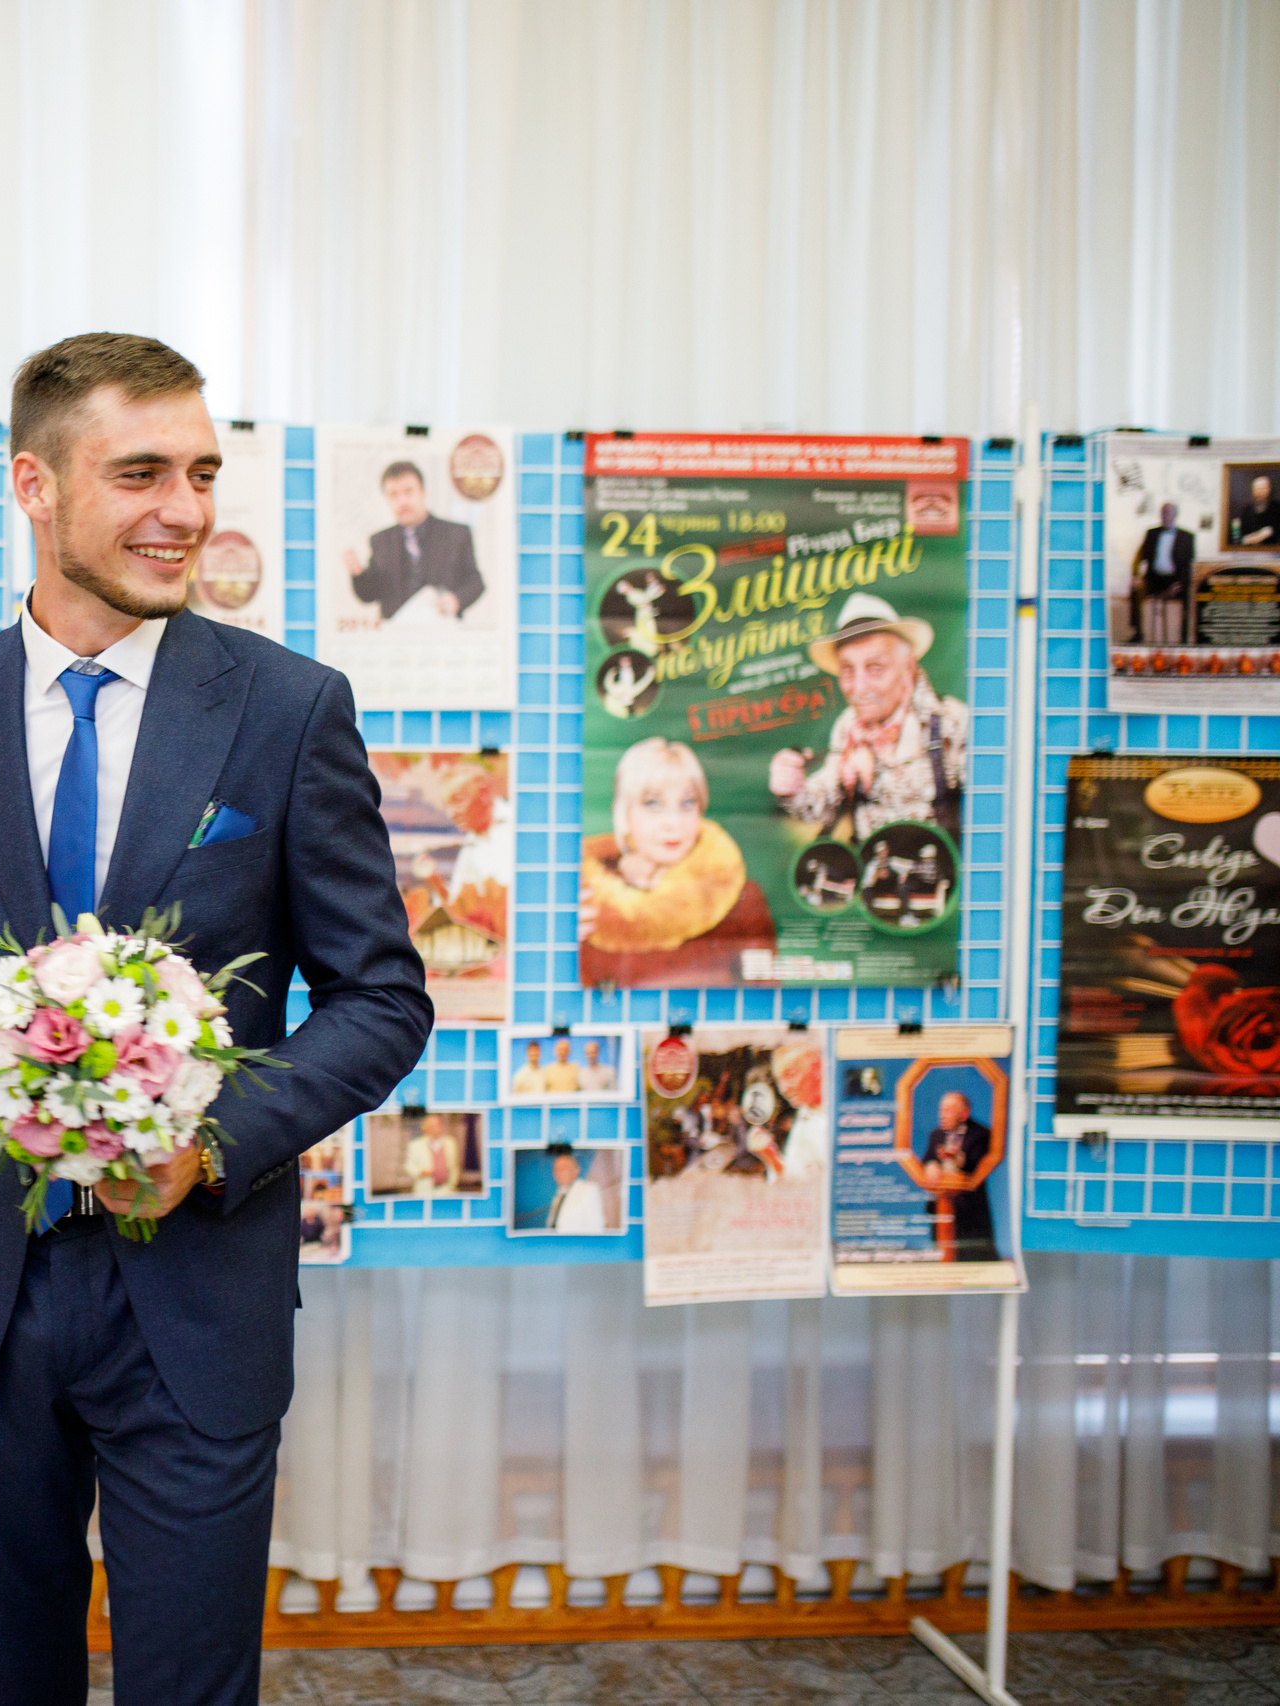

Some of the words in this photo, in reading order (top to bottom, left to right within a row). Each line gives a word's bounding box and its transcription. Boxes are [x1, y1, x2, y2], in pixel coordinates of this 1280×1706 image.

[600, 511, 662, 557] 24
[728, 509, 786, 533] 18:00
[638, 523, 921, 644] Змішані
